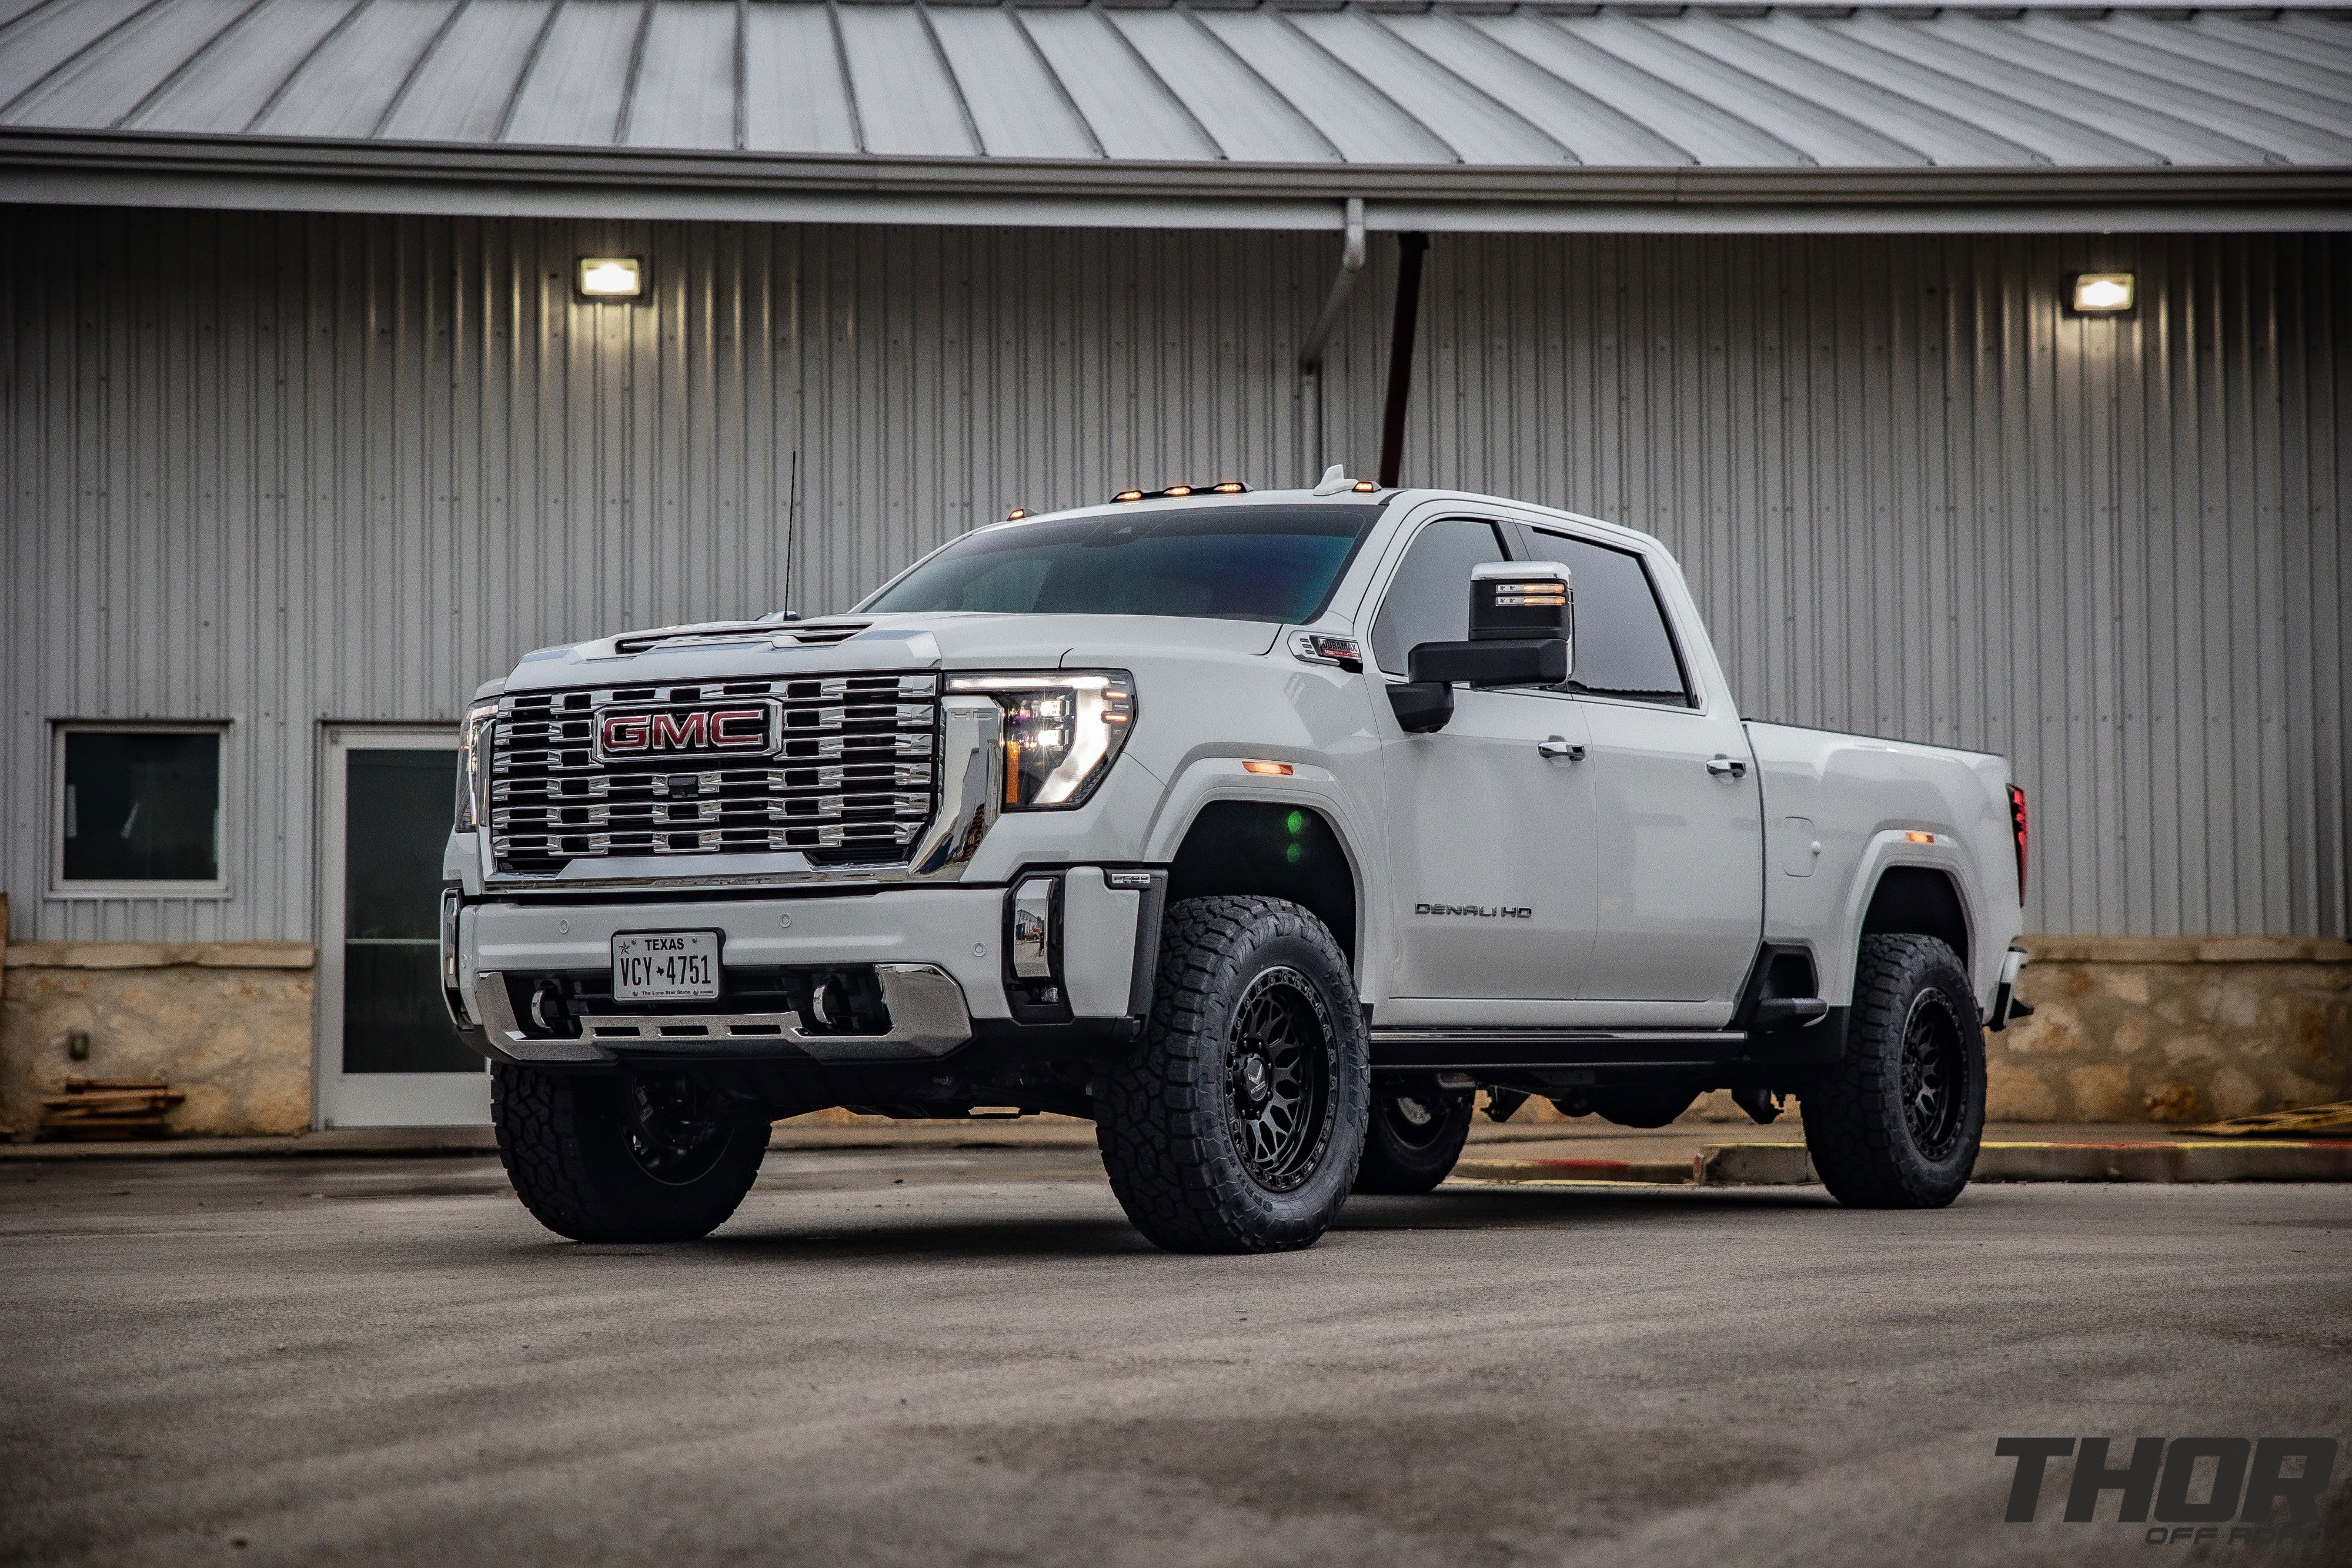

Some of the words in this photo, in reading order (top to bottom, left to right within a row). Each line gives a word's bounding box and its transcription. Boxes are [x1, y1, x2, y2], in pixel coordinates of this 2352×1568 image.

[1323, 640, 1357, 652] DURAMAX
[951, 711, 993, 720] HD
[603, 710, 764, 751] GMC
[1415, 902, 1496, 917] DENALI
[1501, 906, 1532, 918] HD
[645, 938, 684, 951] TEXAS
[620, 957, 652, 986] VCY
[666, 955, 711, 985] 4751
